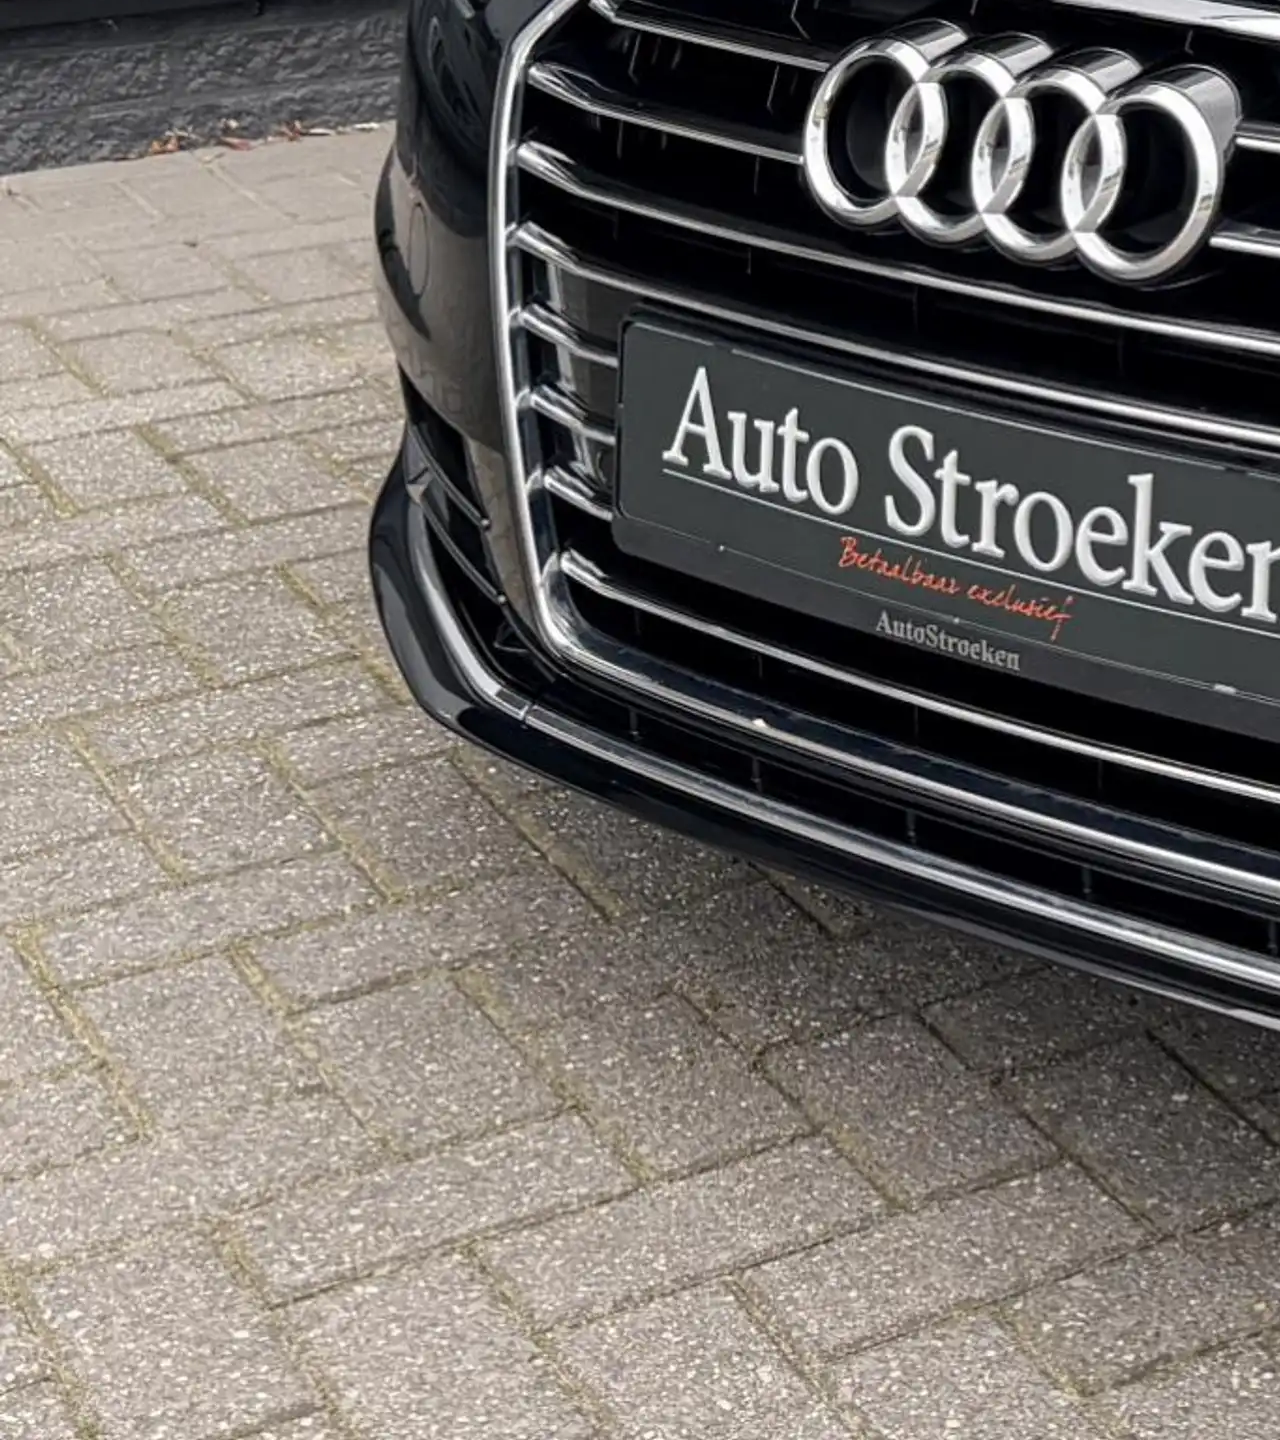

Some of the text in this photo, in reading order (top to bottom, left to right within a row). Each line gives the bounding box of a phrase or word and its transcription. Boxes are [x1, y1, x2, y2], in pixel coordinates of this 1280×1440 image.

[661, 366, 859, 515] Auto
[838, 536, 1075, 642] Betaalbaar exclusief
[875, 610, 1021, 672] AutoStroeken
